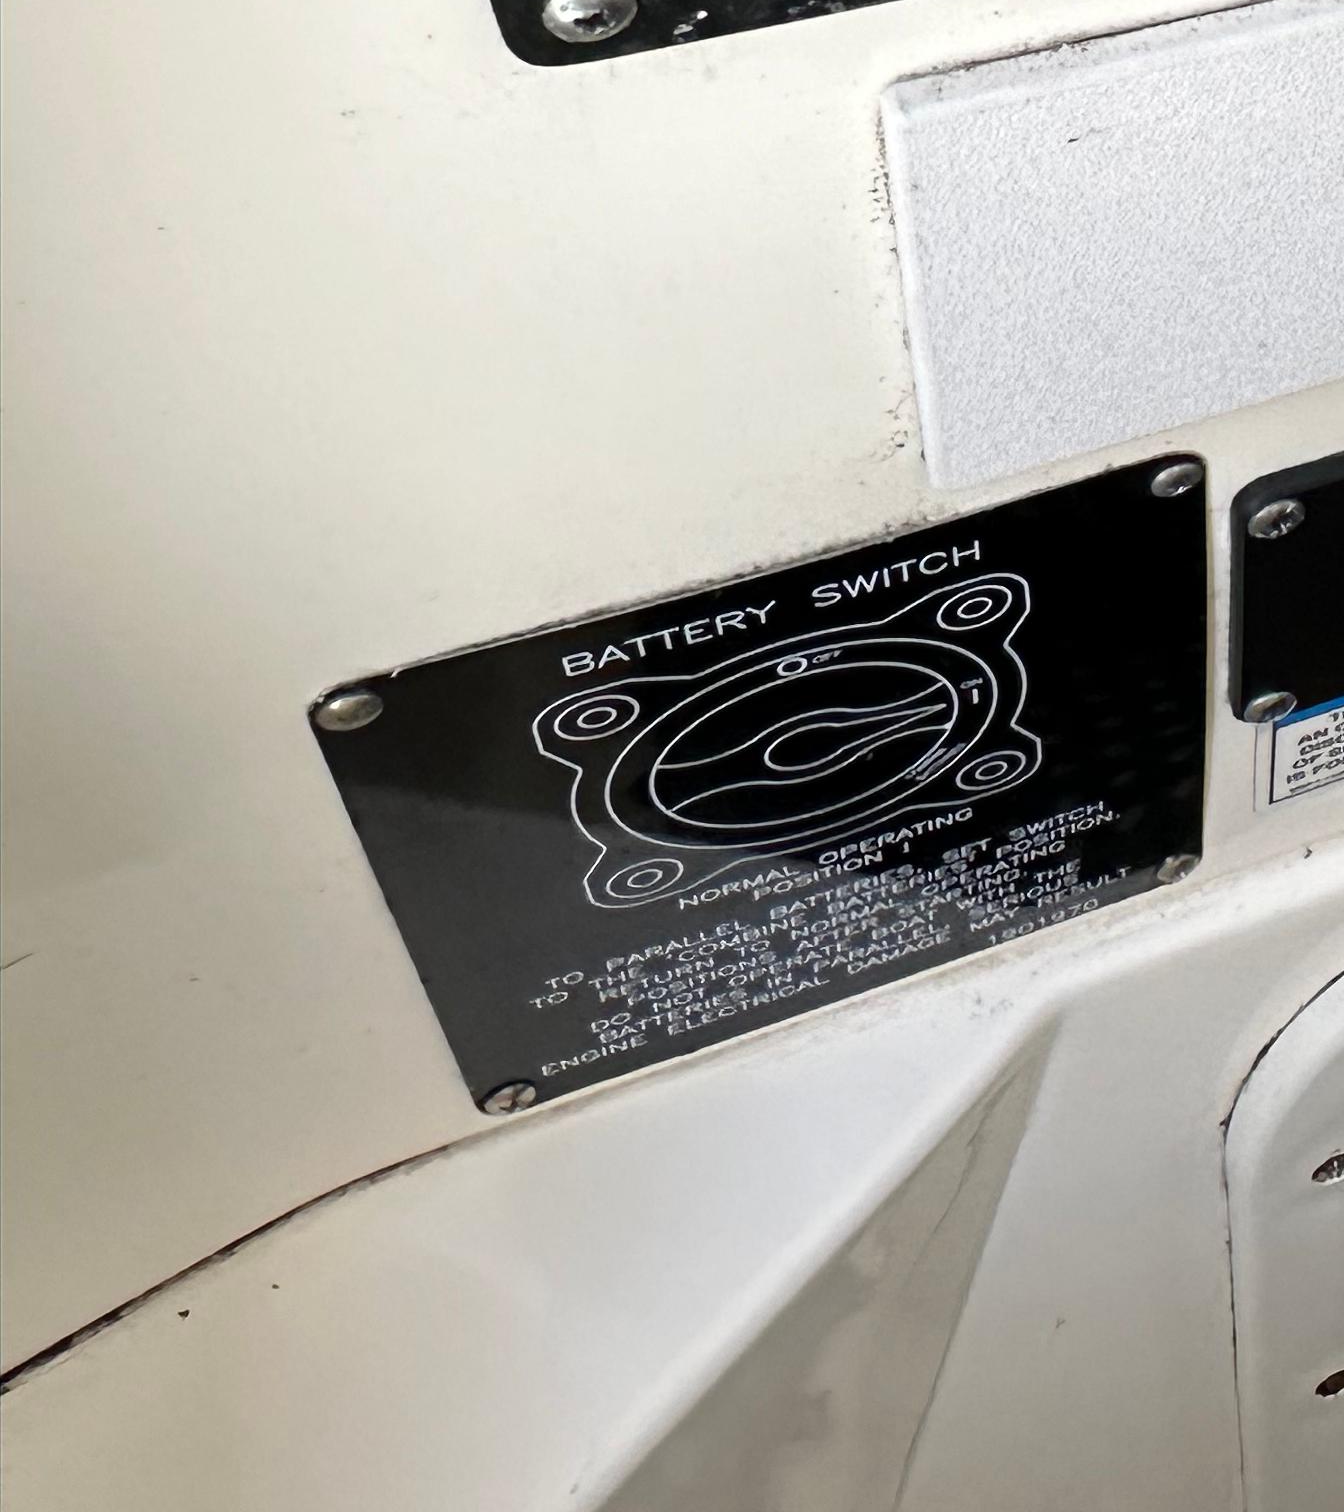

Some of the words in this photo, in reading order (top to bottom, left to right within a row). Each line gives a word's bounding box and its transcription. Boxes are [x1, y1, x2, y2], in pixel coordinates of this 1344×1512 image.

[561, 600, 777, 678] BATTERY
[811, 539, 981, 609] SWITCH
[1294, 726, 1331, 746] AN
[677, 861, 800, 910] NORMAL
[816, 806, 975, 867] OPERATING
[751, 849, 884, 900] POSITION
[543, 968, 585, 993] TO
[604, 916, 751, 973] PARALLEL
[589, 1009, 633, 1033] DO
[650, 985, 707, 1013] NOT
[869, 908, 939, 941] BOAT
[955, 880, 1018, 911] WITH
[597, 955, 716, 1004] RETURN
[732, 936, 772, 959] TO
[789, 894, 902, 941] NORMAL
[919, 838, 1069, 897] OPERATING
[528, 989, 569, 1011] TO
[587, 963, 647, 992] THE
[540, 1031, 648, 1077] ENGINE
[665, 970, 831, 1037] ELECTRICAL
[844, 930, 952, 976] DAMAGE
[968, 903, 1024, 933] MAY
[596, 985, 748, 1043] BATTERIES
[765, 969, 794, 989] IN
